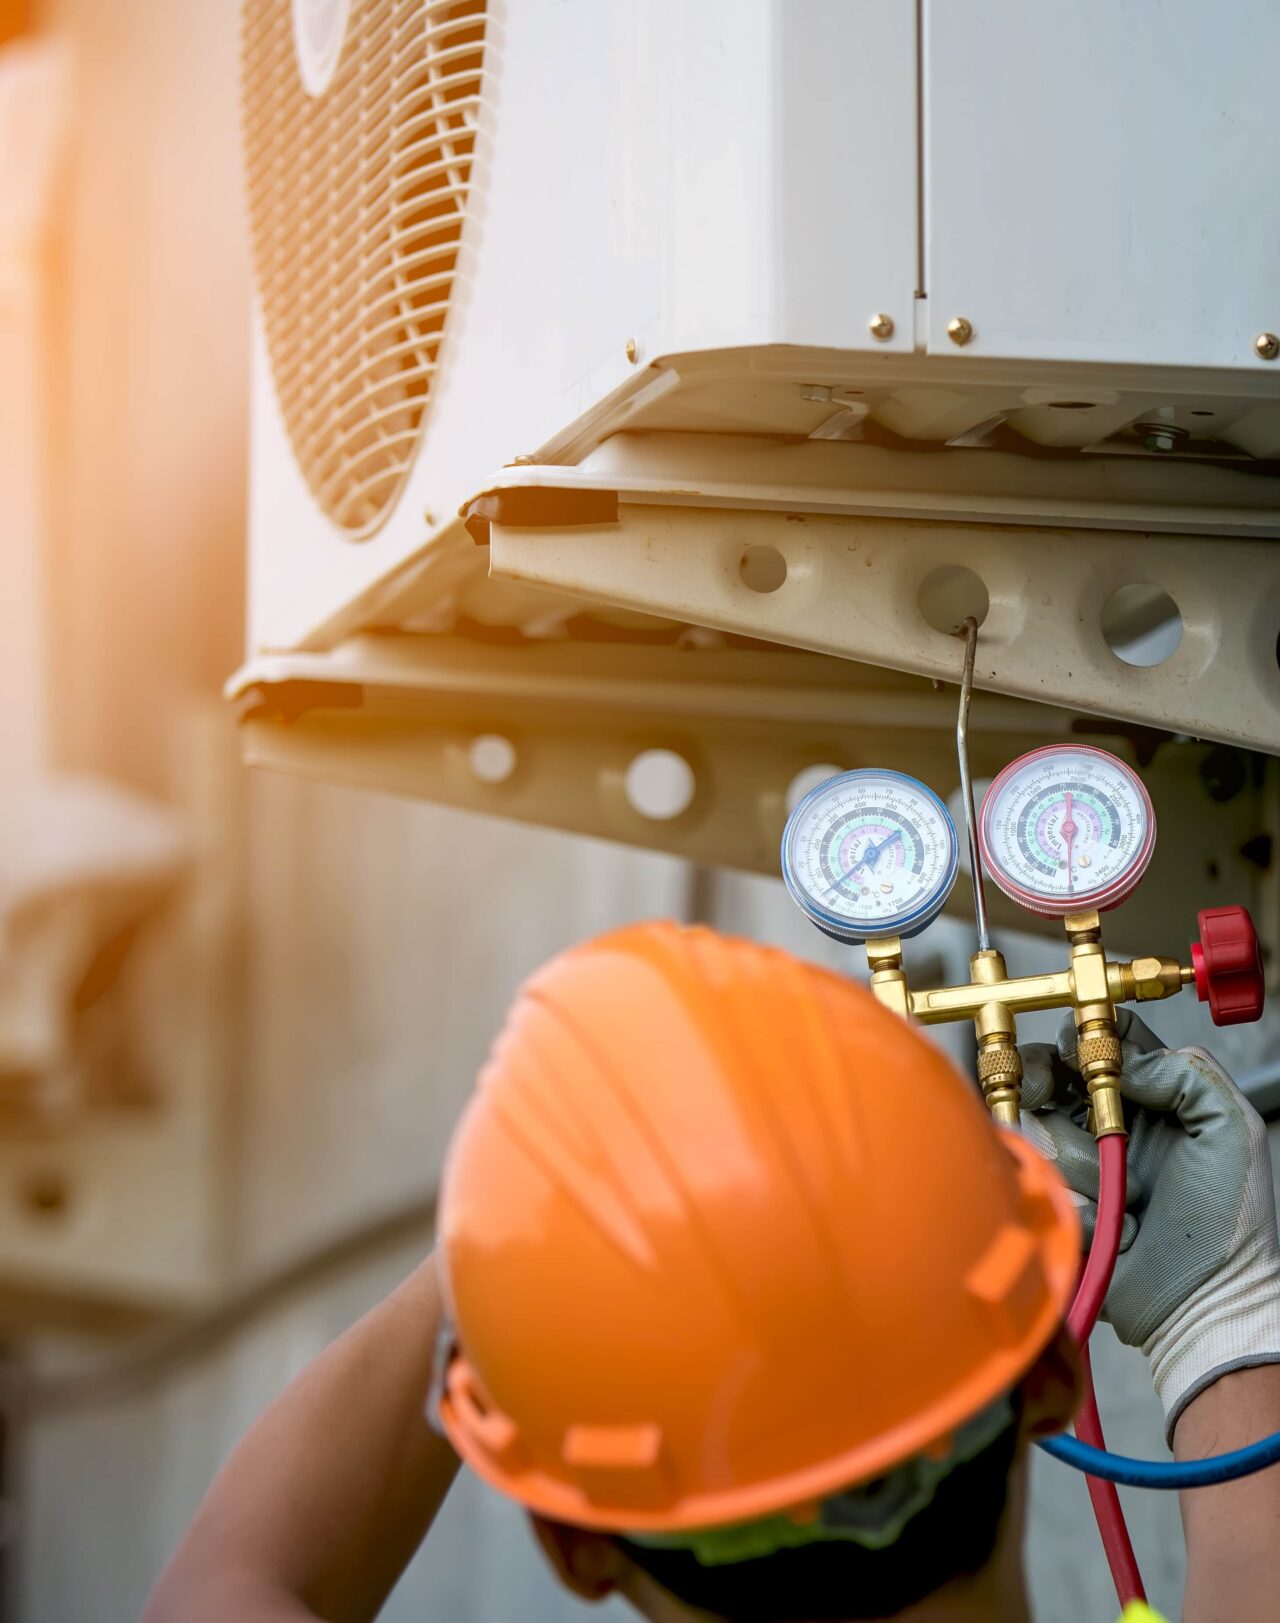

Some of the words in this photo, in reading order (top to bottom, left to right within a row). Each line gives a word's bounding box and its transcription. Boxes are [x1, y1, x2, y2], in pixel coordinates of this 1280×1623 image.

[1117, 781, 1127, 790] 350
[1027, 786, 1042, 797] 1500
[1110, 794, 1121, 807] 2500
[911, 818, 921, 828] 600
[1047, 814, 1062, 849] Imperial
[1023, 863, 1034, 872] 500
[1094, 865, 1110, 876] 3400
[918, 872, 927, 884] 800
[888, 897, 903, 907] 1700
